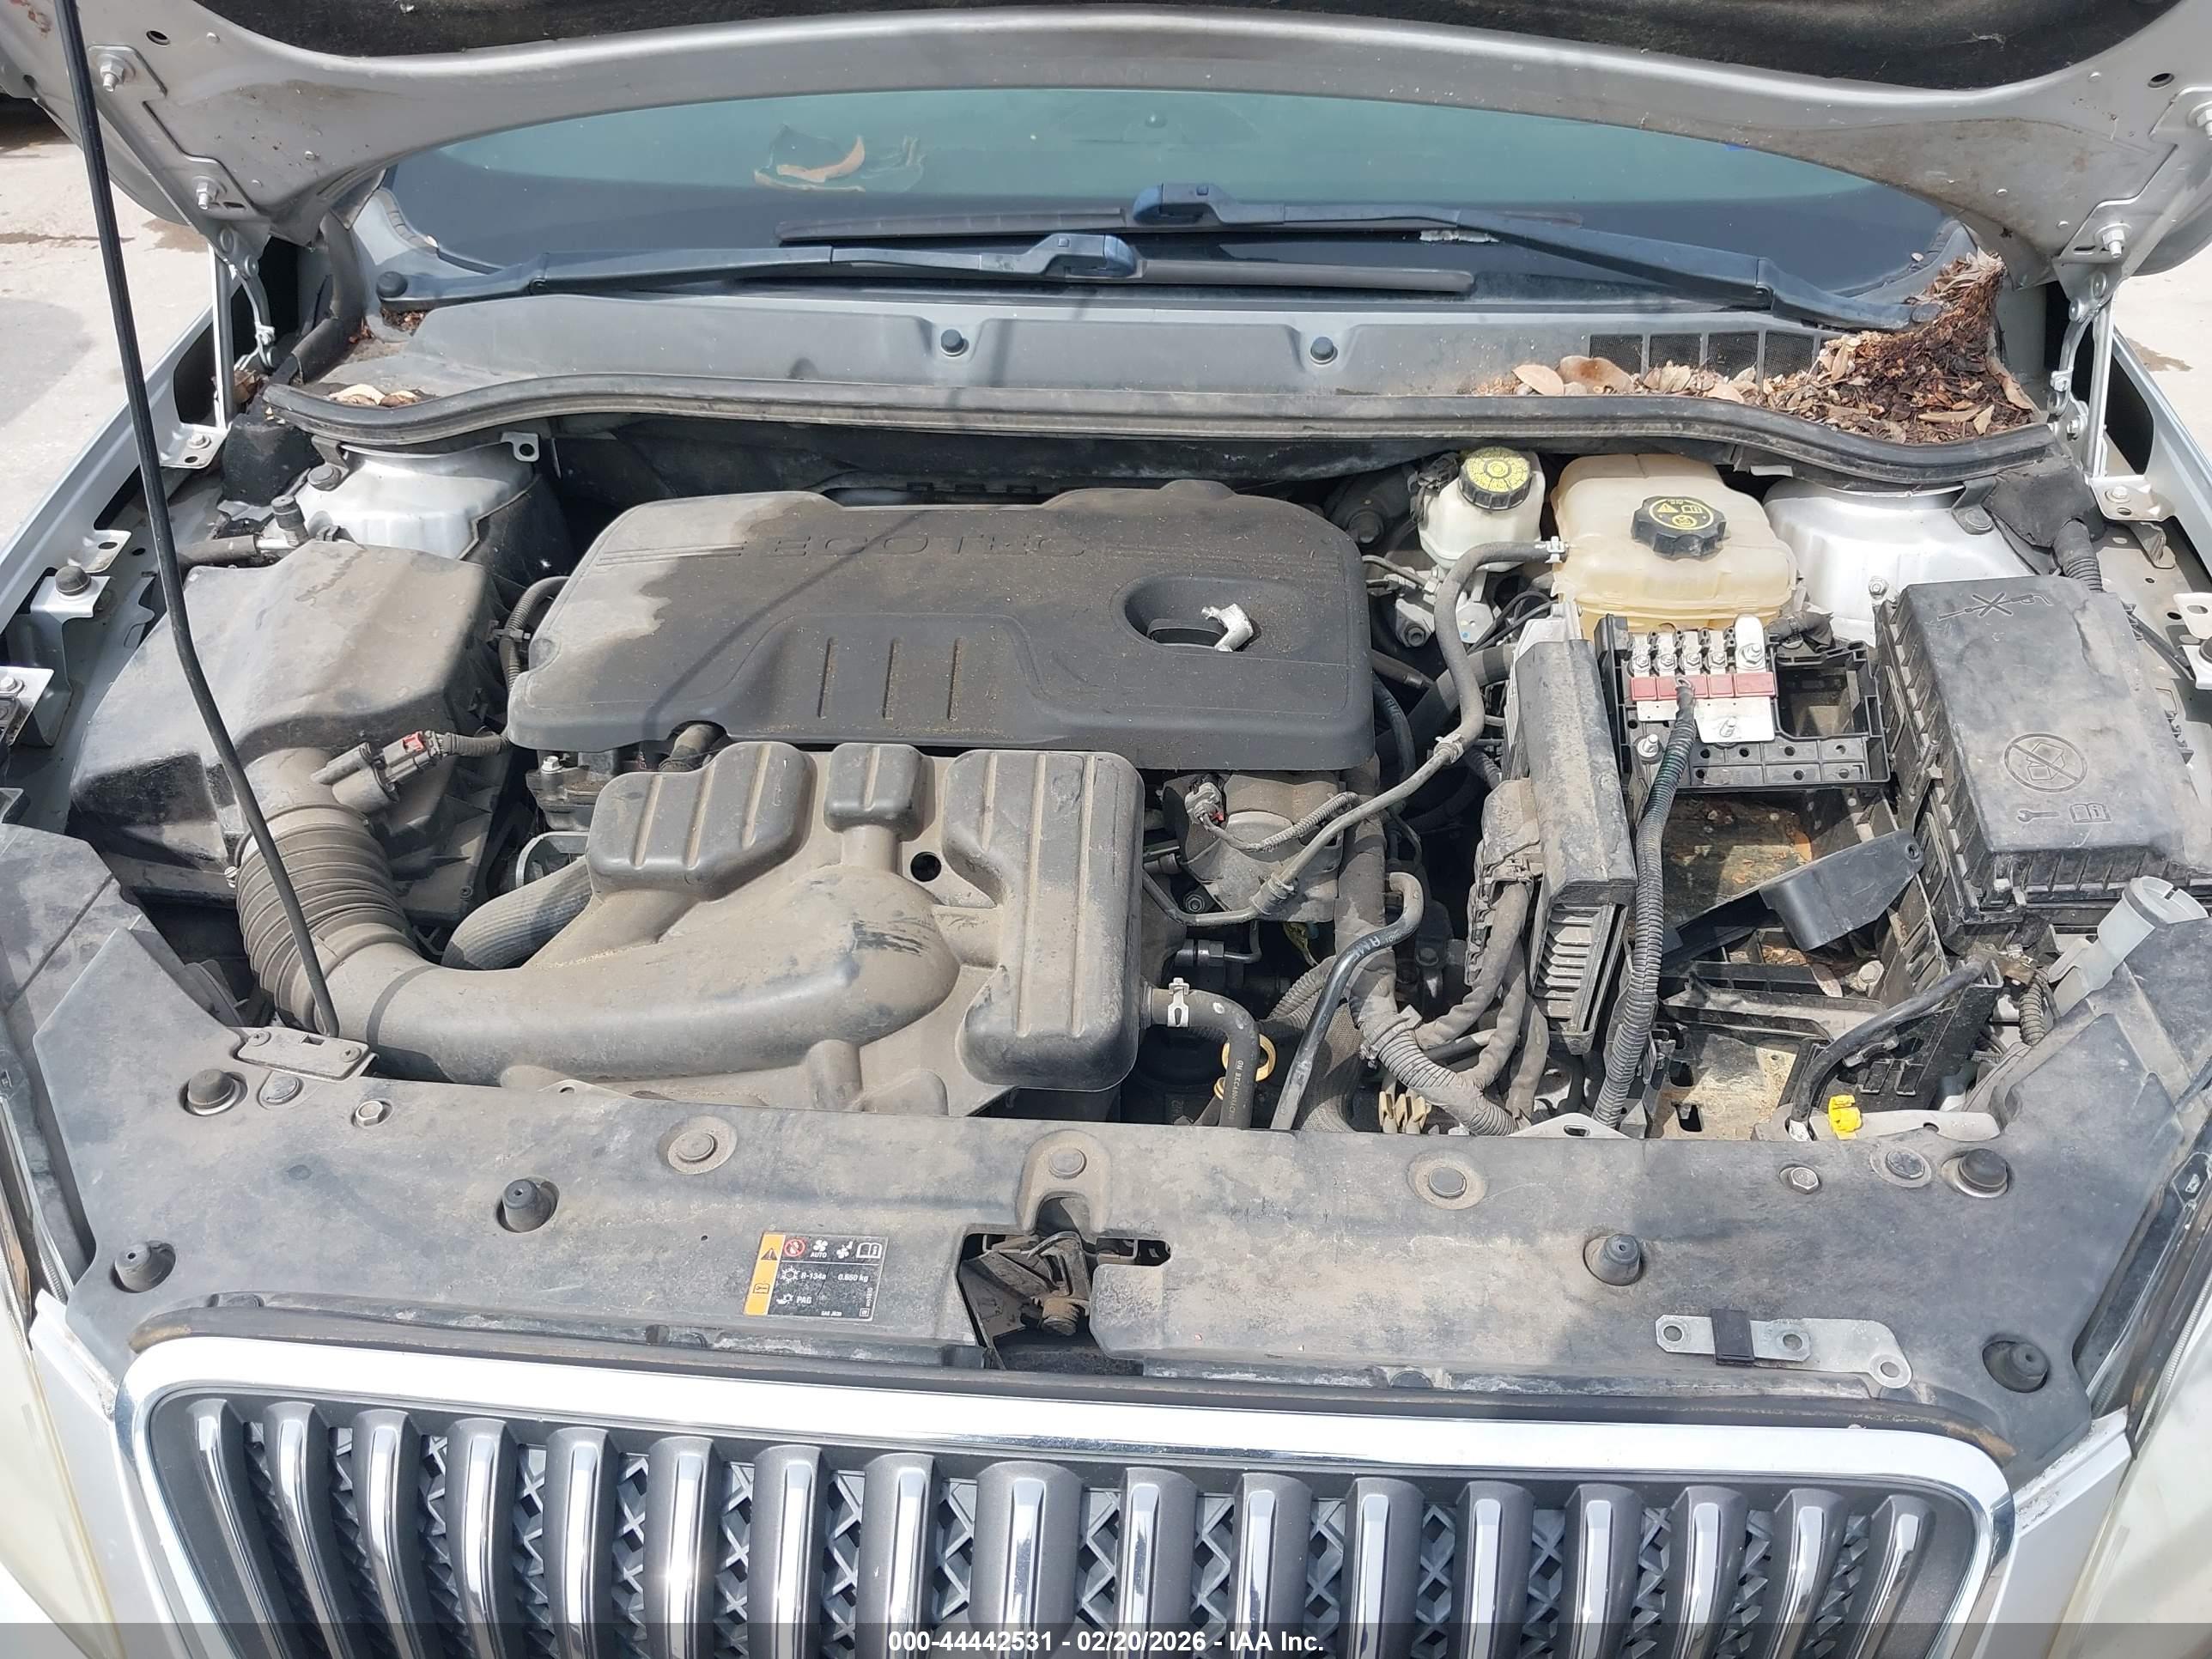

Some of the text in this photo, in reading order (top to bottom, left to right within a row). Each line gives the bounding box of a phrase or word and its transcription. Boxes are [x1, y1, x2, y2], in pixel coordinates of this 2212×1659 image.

[800, 1272, 827, 1280] R-134a
[859, 1273, 869, 1283] kg
[796, 1295, 812, 1304] PAG
